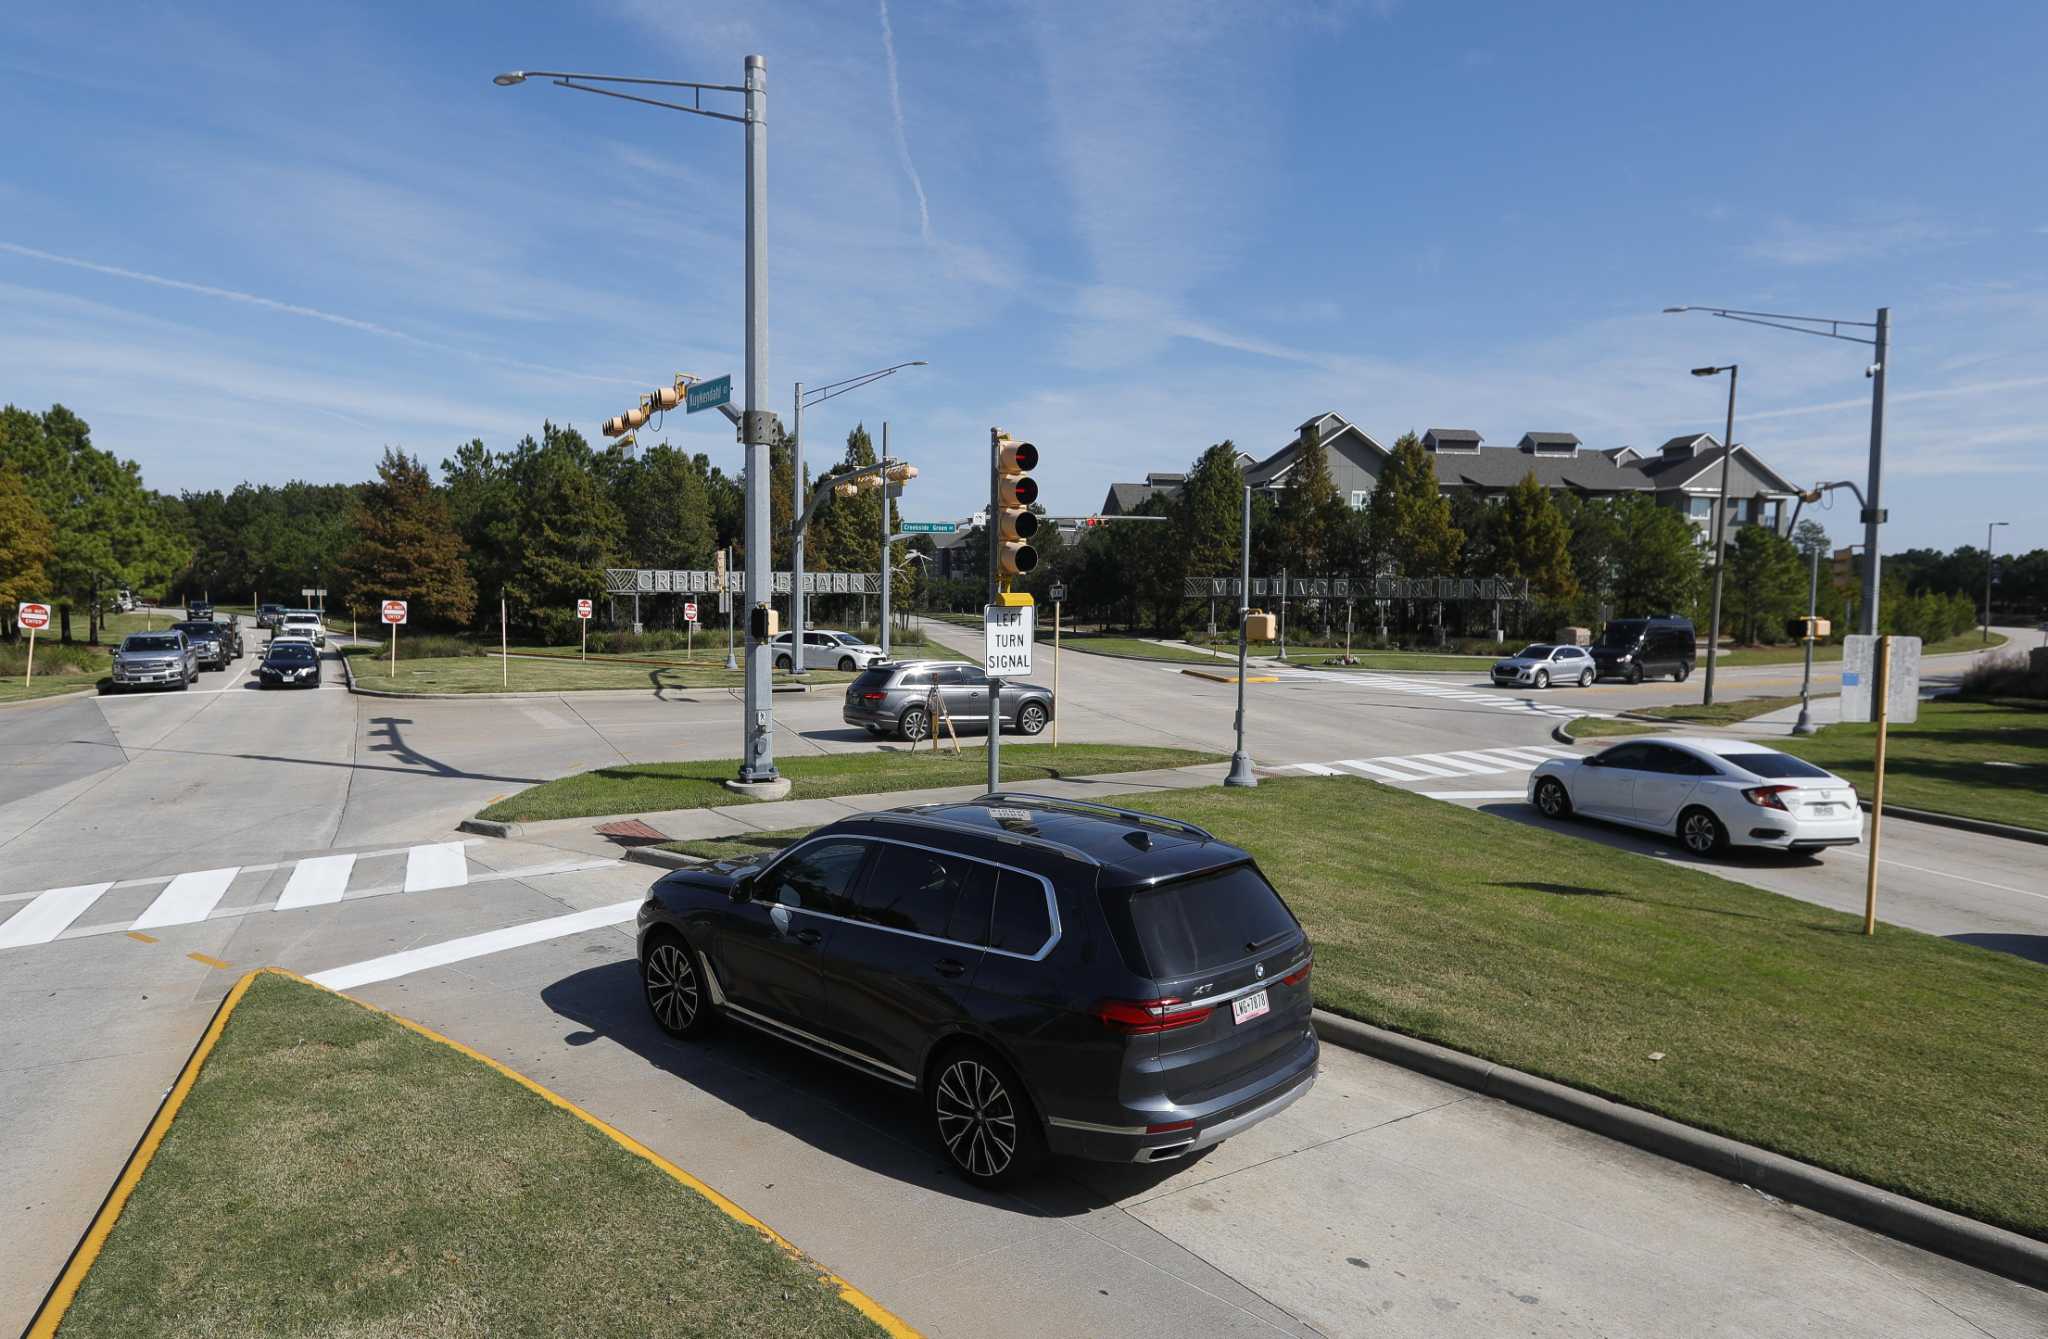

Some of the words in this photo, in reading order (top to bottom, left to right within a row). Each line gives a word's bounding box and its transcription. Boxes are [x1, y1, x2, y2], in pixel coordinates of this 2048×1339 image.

[802, 575, 863, 591] PARK
[996, 613, 1023, 627] LEFT
[995, 634, 1024, 648] TURN
[988, 655, 1030, 668] SIGNAL
